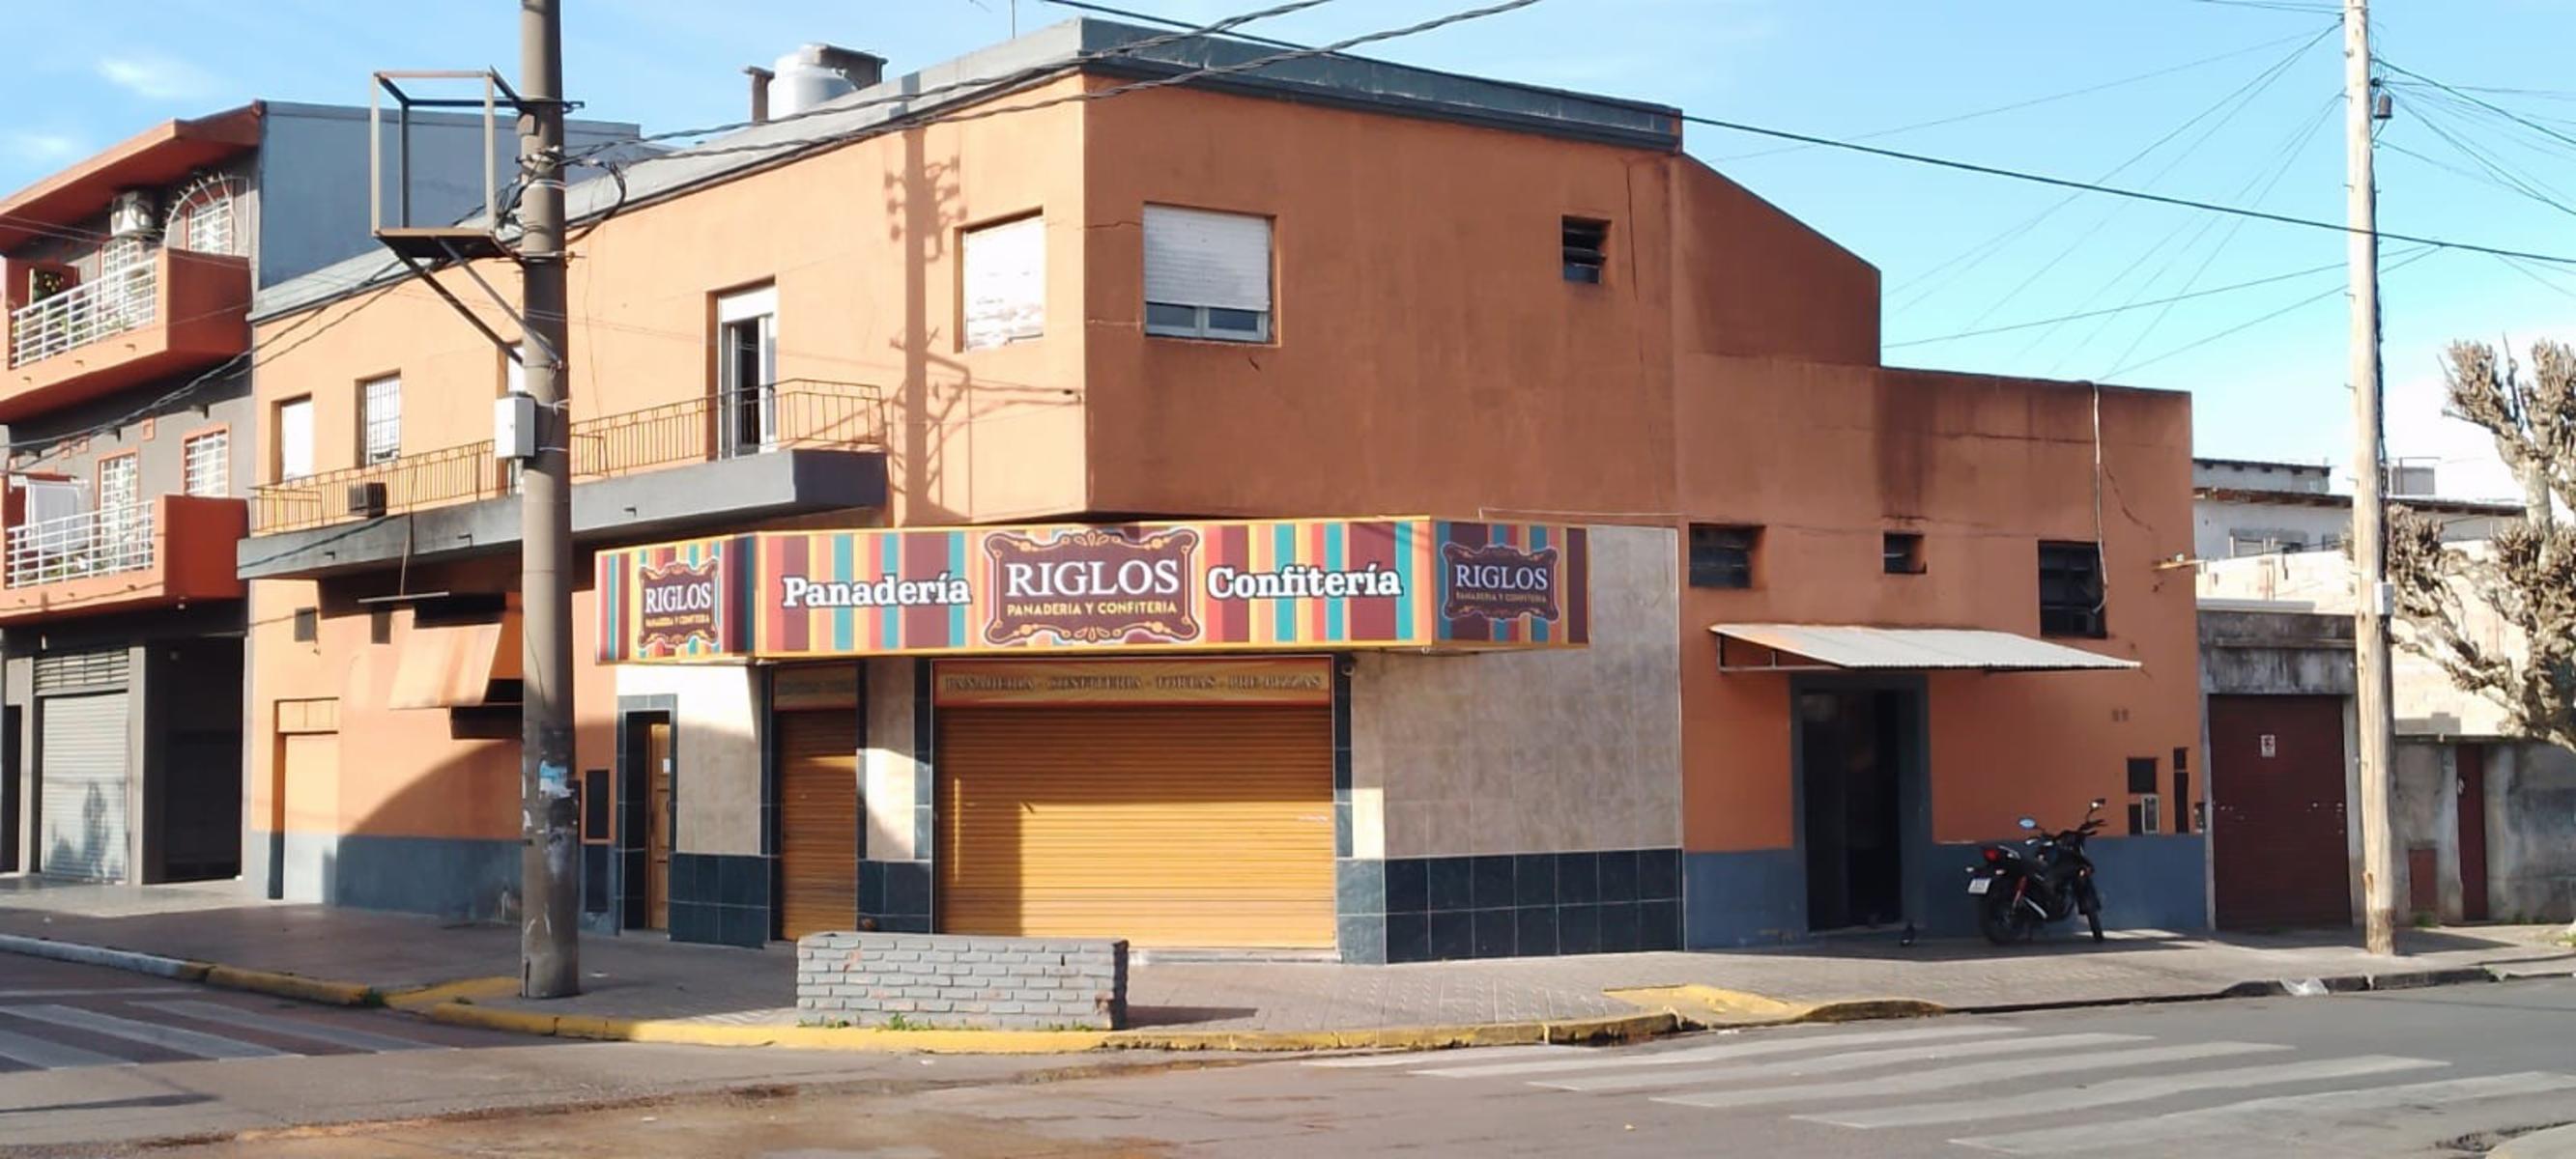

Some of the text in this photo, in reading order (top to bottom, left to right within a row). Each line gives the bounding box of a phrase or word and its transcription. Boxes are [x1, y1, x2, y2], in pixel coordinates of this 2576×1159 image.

[782, 572, 971, 608] Panadería
[1005, 558, 1180, 597] RIGLOS
[1206, 561, 1404, 599] Confitería
[1455, 564, 1548, 591] RIGLOS
[644, 581, 711, 613] RIGLOS
[1007, 601, 1178, 616] PANADERIA Y CONFITERIA
